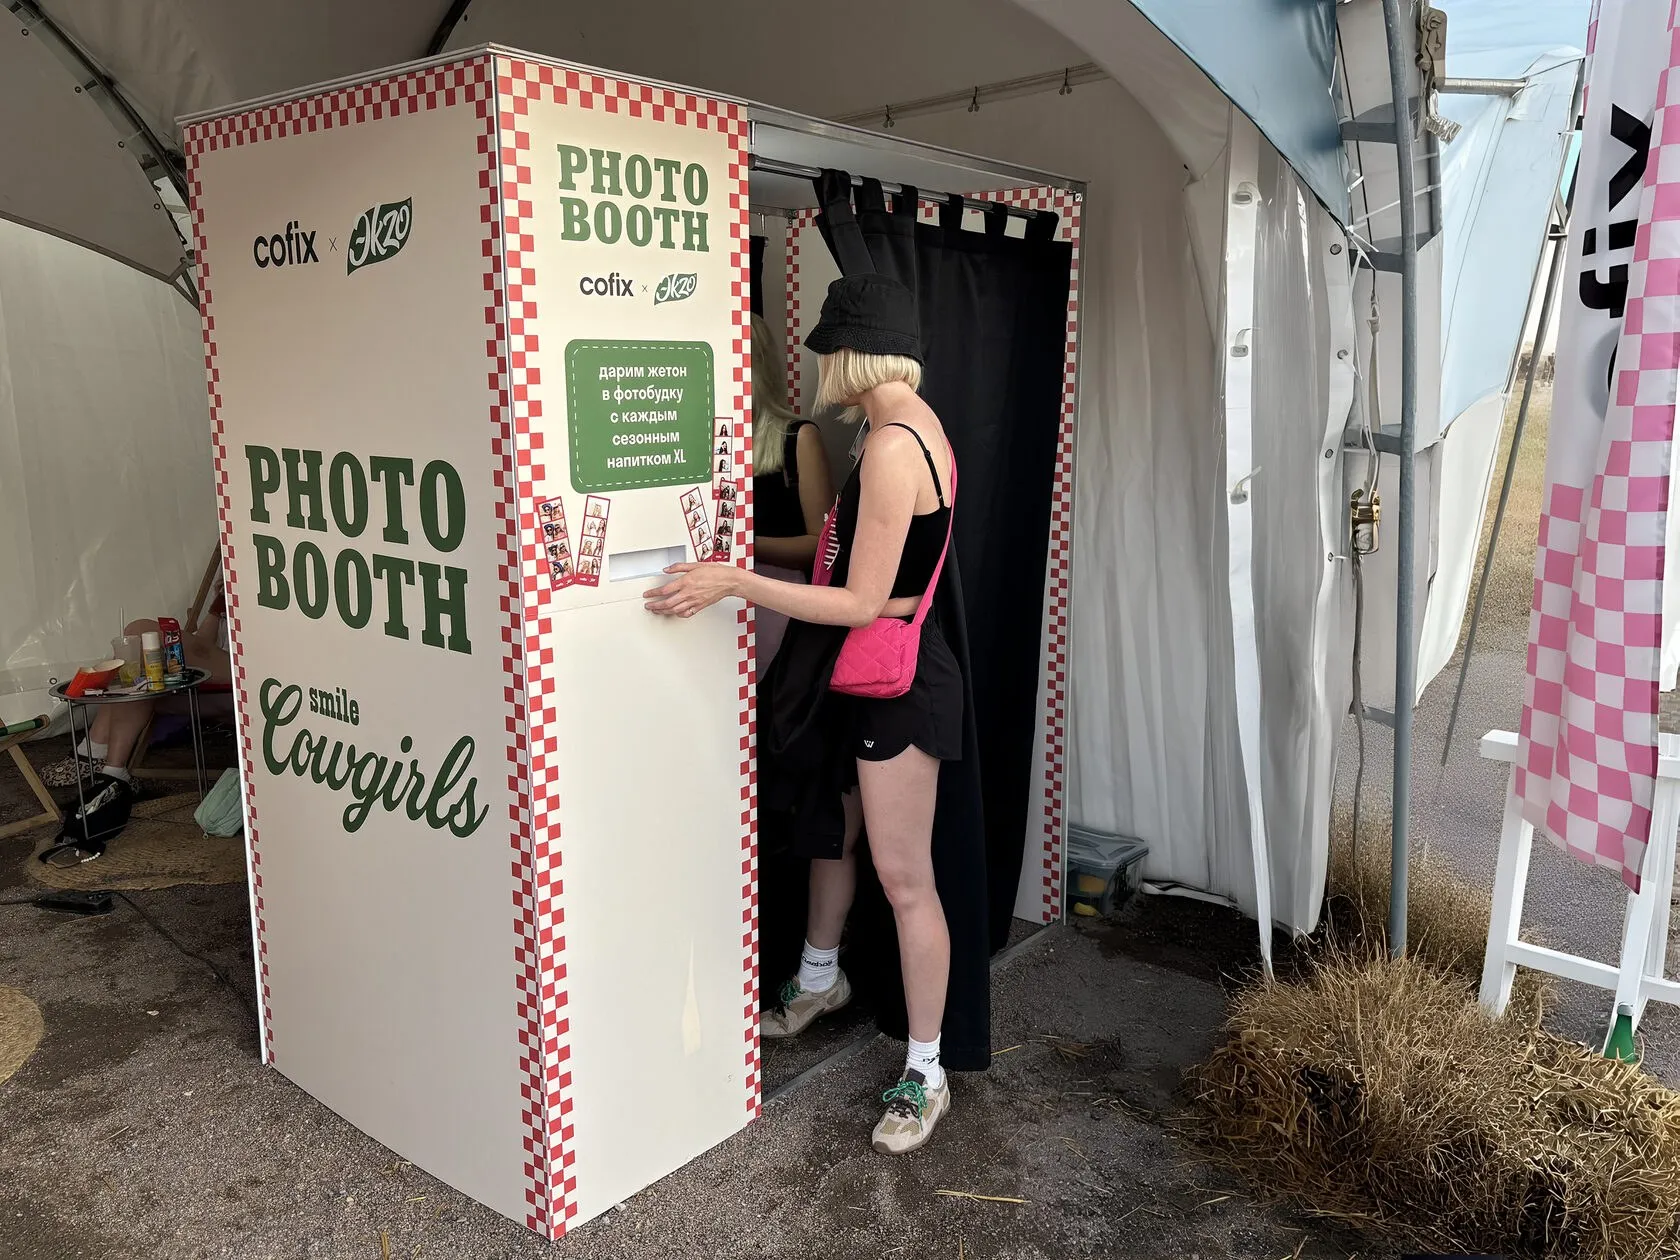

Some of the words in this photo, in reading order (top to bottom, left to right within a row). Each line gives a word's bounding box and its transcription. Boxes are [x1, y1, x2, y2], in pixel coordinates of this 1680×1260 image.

[556, 143, 709, 207] PHOTO
[253, 220, 320, 269] cofix
[559, 196, 710, 253] BOOTH
[579, 272, 634, 297] cofix
[598, 366, 645, 382] дарим
[647, 366, 687, 378] жетон
[602, 389, 611, 401] в
[613, 385, 684, 405] фотобудку
[610, 412, 619, 424] с
[622, 410, 678, 425] каждым
[606, 453, 672, 469] напитком
[673, 448, 687, 464] XL
[612, 431, 680, 446] сезонным
[244, 444, 466, 553] PHOTO
[252, 533, 472, 655] BOOTH
[308, 686, 360, 727] smile
[259, 677, 490, 839] Cowgirls
